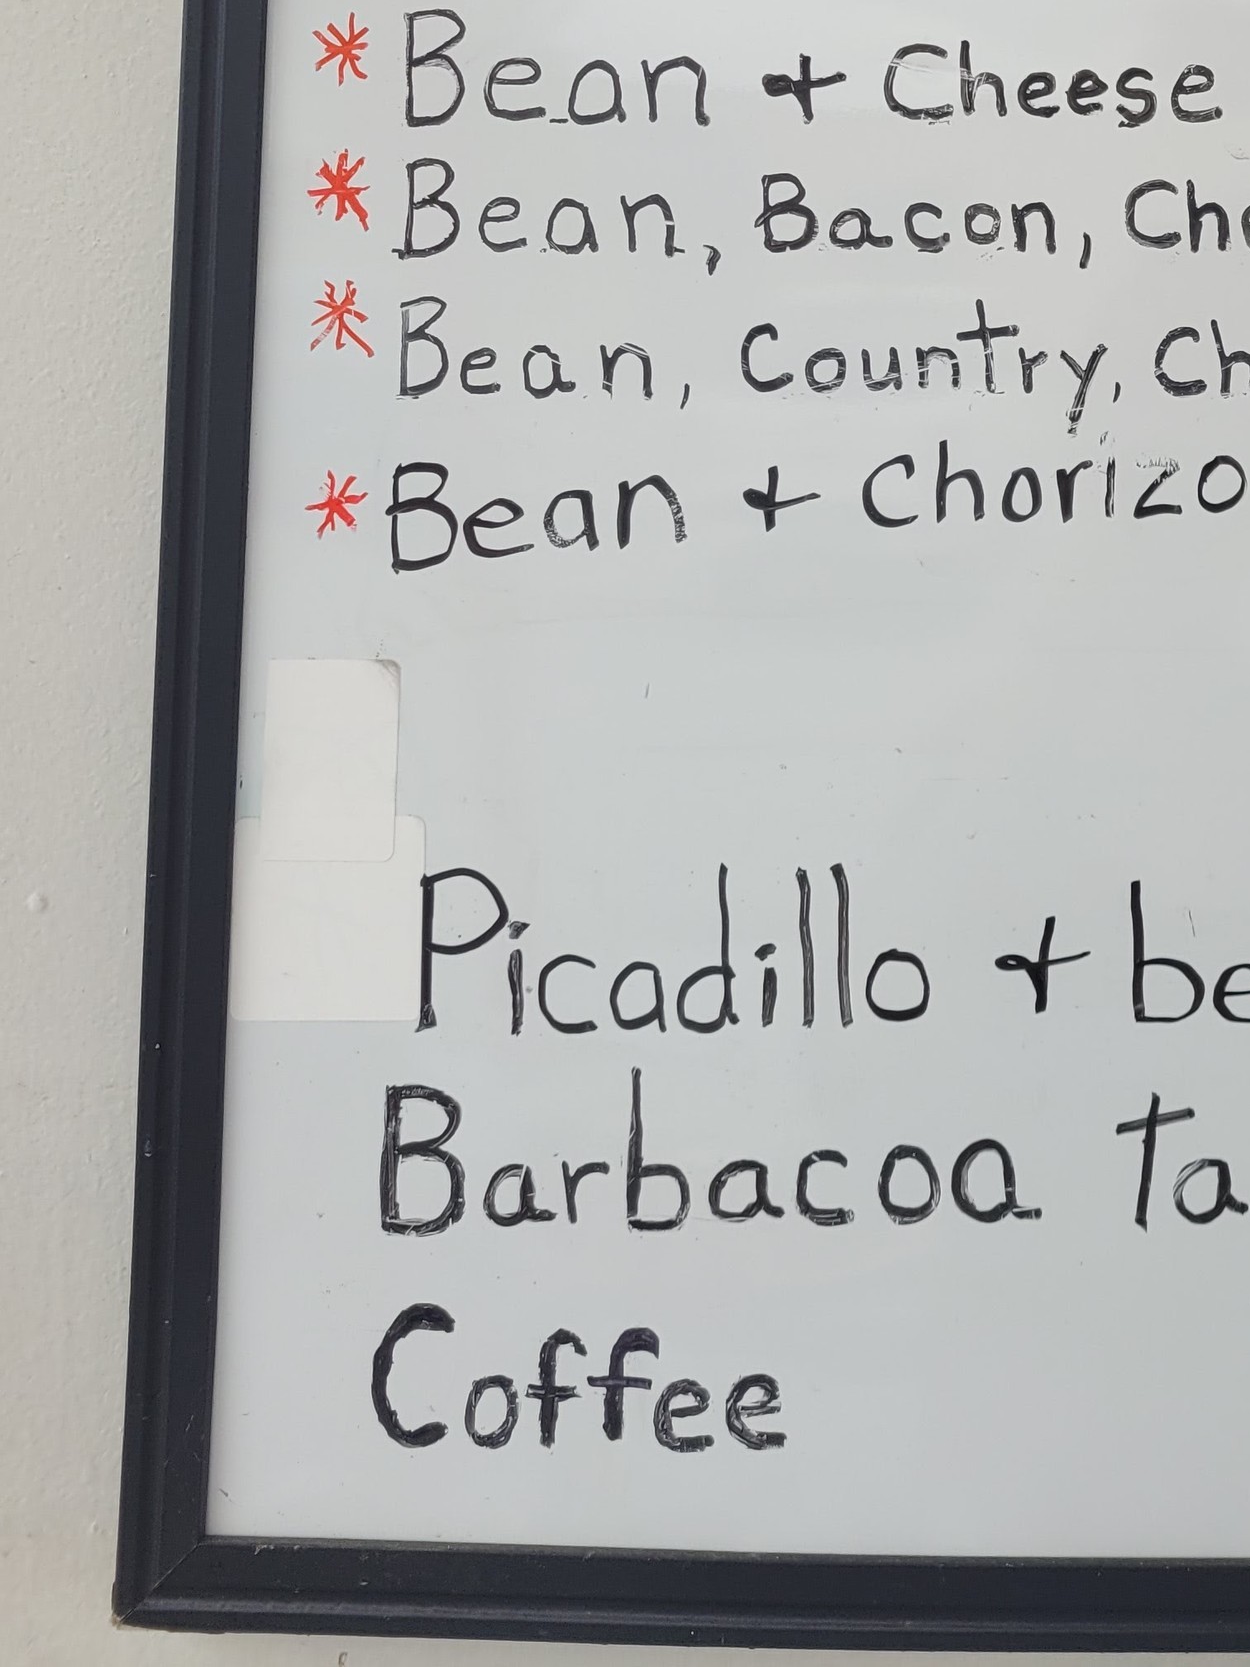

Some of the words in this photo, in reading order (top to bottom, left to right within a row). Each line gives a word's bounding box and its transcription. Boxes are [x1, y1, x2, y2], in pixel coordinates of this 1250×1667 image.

[404, 7, 710, 129] Bean
[882, 38, 1224, 130] Cheese
[390, 156, 722, 277] Bean,
[753, 171, 1092, 271] Bacon,
[398, 294, 691, 411] Bean,
[739, 297, 1122, 436] Country,
[384, 460, 688, 576] Bean
[861, 438, 1248, 529] Chorizo
[414, 861, 931, 1037] Picadillo
[378, 1067, 1044, 1236] Barbacoa
[369, 1302, 788, 1454] Coffee
